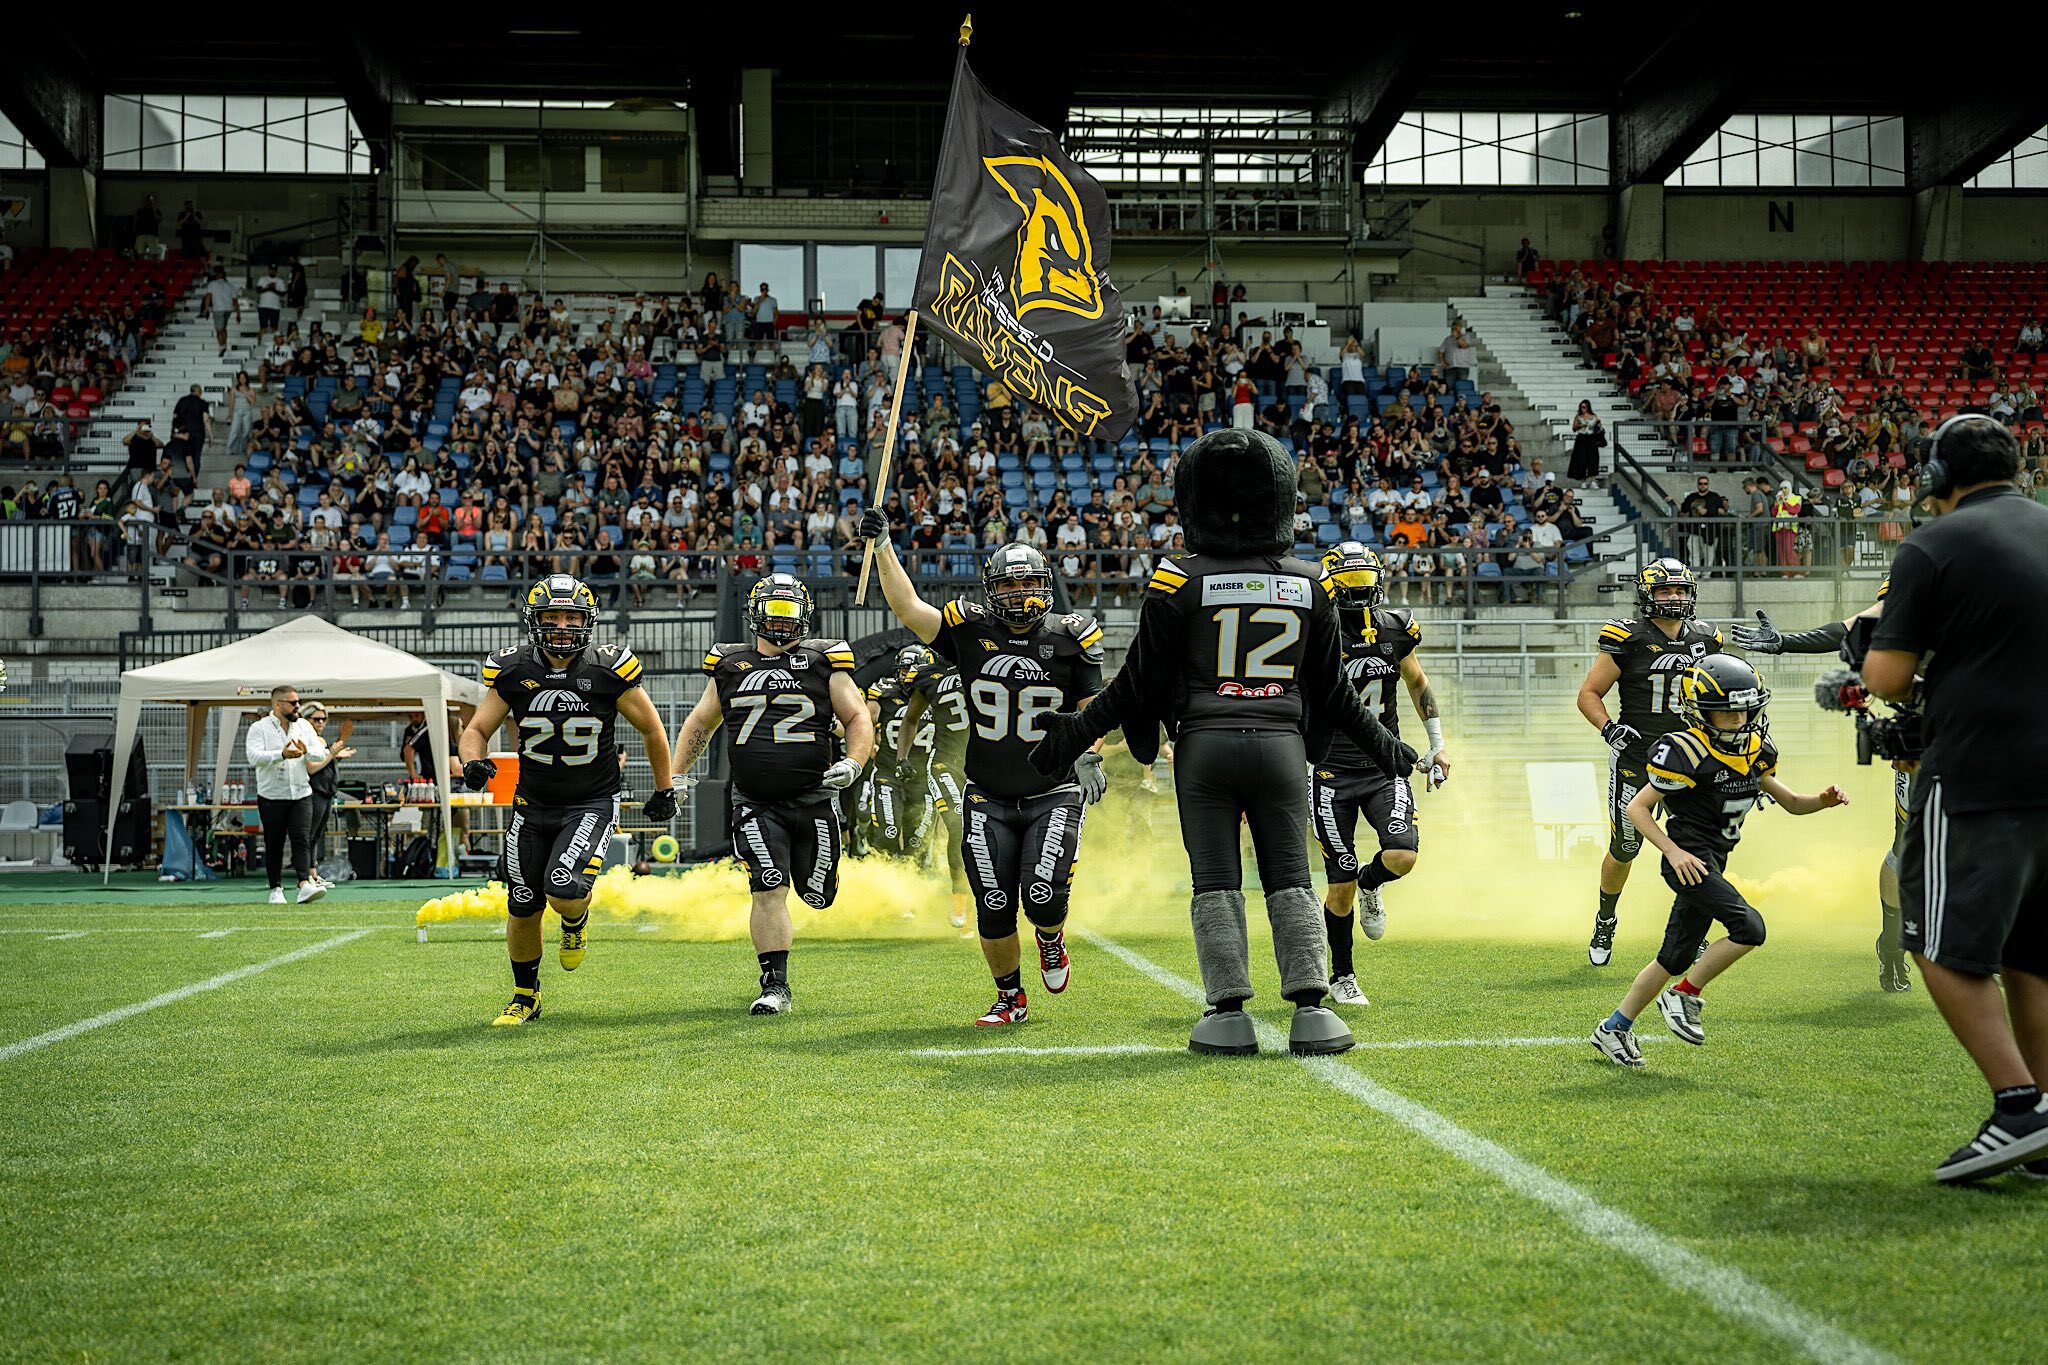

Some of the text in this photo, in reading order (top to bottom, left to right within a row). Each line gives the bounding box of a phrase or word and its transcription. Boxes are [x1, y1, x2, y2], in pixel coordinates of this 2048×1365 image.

[1769, 201, 1793, 232] N
[931, 252, 1112, 436] RAVENS
[57, 500, 77, 519] 27
[1209, 582, 1243, 591] KAISER
[1213, 608, 1301, 679] 12
[768, 680, 802, 690] SWK
[1014, 669, 1051, 681] SWK
[1367, 664, 1396, 676] SWK
[557, 702, 590, 712] SWK
[730, 694, 816, 745] 72
[970, 678, 1064, 743] 98
[519, 716, 603, 766] 29
[1652, 743, 1672, 766] 3
[1896, 771, 1907, 798] ENS
[559, 812, 600, 871] Borgmann
[1317, 785, 1349, 853] Borgmann
[1721, 797, 1756, 840] 3
[806, 818, 834, 894] Borgmann
[966, 809, 999, 889] Borgmann
[1034, 807, 1069, 882] Borgmann
